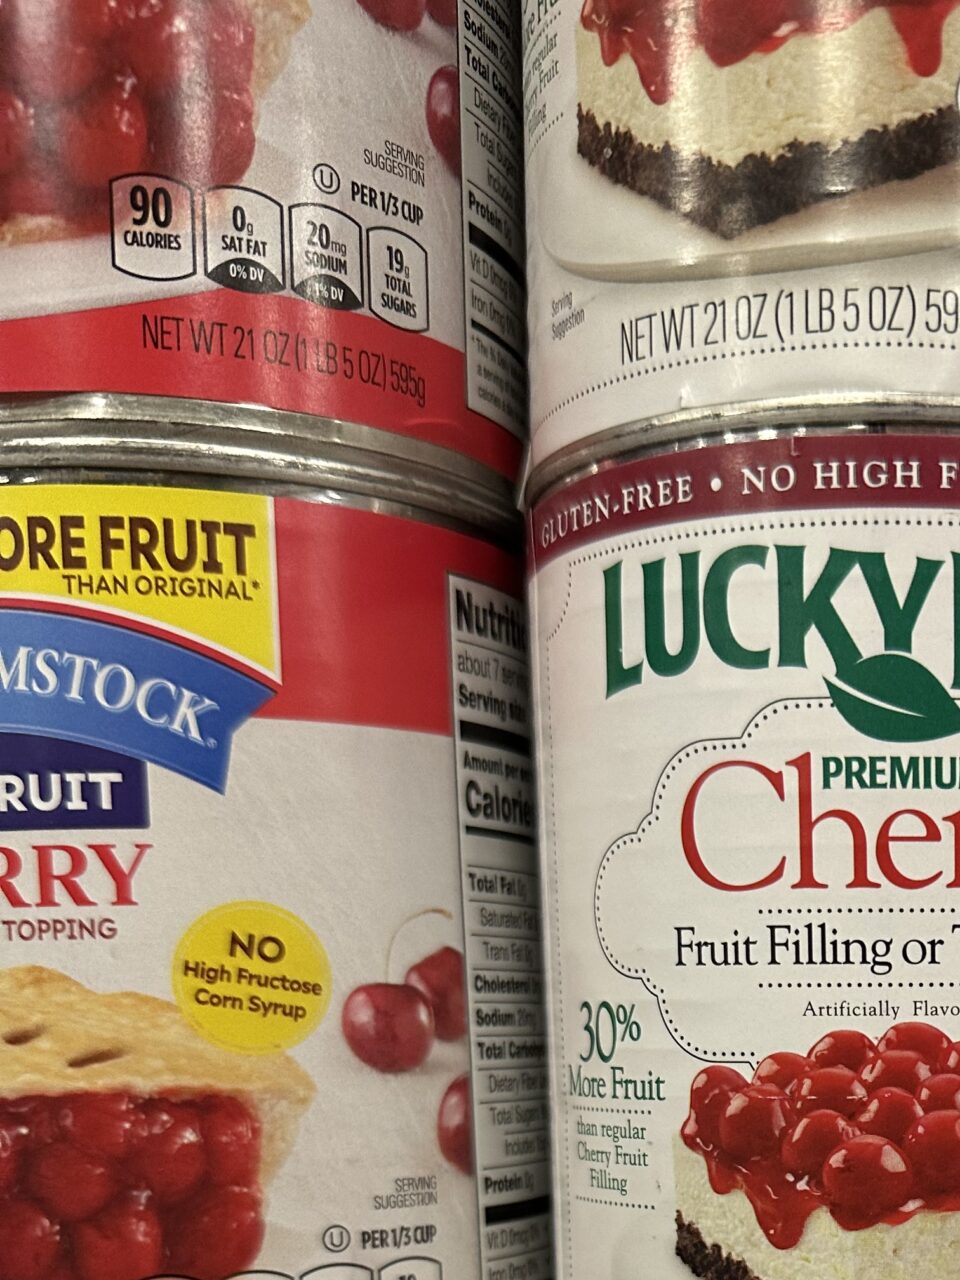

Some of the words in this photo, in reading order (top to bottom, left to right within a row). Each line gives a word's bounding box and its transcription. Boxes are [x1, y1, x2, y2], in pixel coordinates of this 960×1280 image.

[129, 185, 173, 228] 90
[351, 180, 378, 205] PER
[379, 190, 400, 216] 1/3
[401, 201, 424, 226] CUP
[124, 230, 182, 251] CALORIES
[540, 475, 694, 549] GLUTEN-FREE
[741, 464, 796, 495] NO
[814, 461, 923, 491] HIGH
[100, 516, 256, 577] FRUIT
[62, 574, 131, 597] THAN
[1, 917, 118, 941] TOPPING
[228, 930, 287, 963] NO
[674, 925, 758, 968] Fruit
[766, 922, 894, 975] Filling
[902, 936, 945, 967] or
[183, 960, 232, 985] High
[237, 968, 322, 996] Fructose
[194, 988, 243, 1011] Corn
[247, 996, 307, 1022] Syrup
[802, 1000, 901, 1020] Artificially
[579, 1000, 642, 1063] 30%
[568, 1064, 607, 1099] More
[610, 1066, 666, 1101] Fruit
[577, 1116, 598, 1137] than
[601, 1119, 647, 1142] regular
[577, 1141, 612, 1168] Cherry
[615, 1145, 649, 1167] Fruit
[589, 1168, 628, 1196] Filling
[361, 1228, 390, 1250] PER
[413, 1224, 438, 1245] CUP
